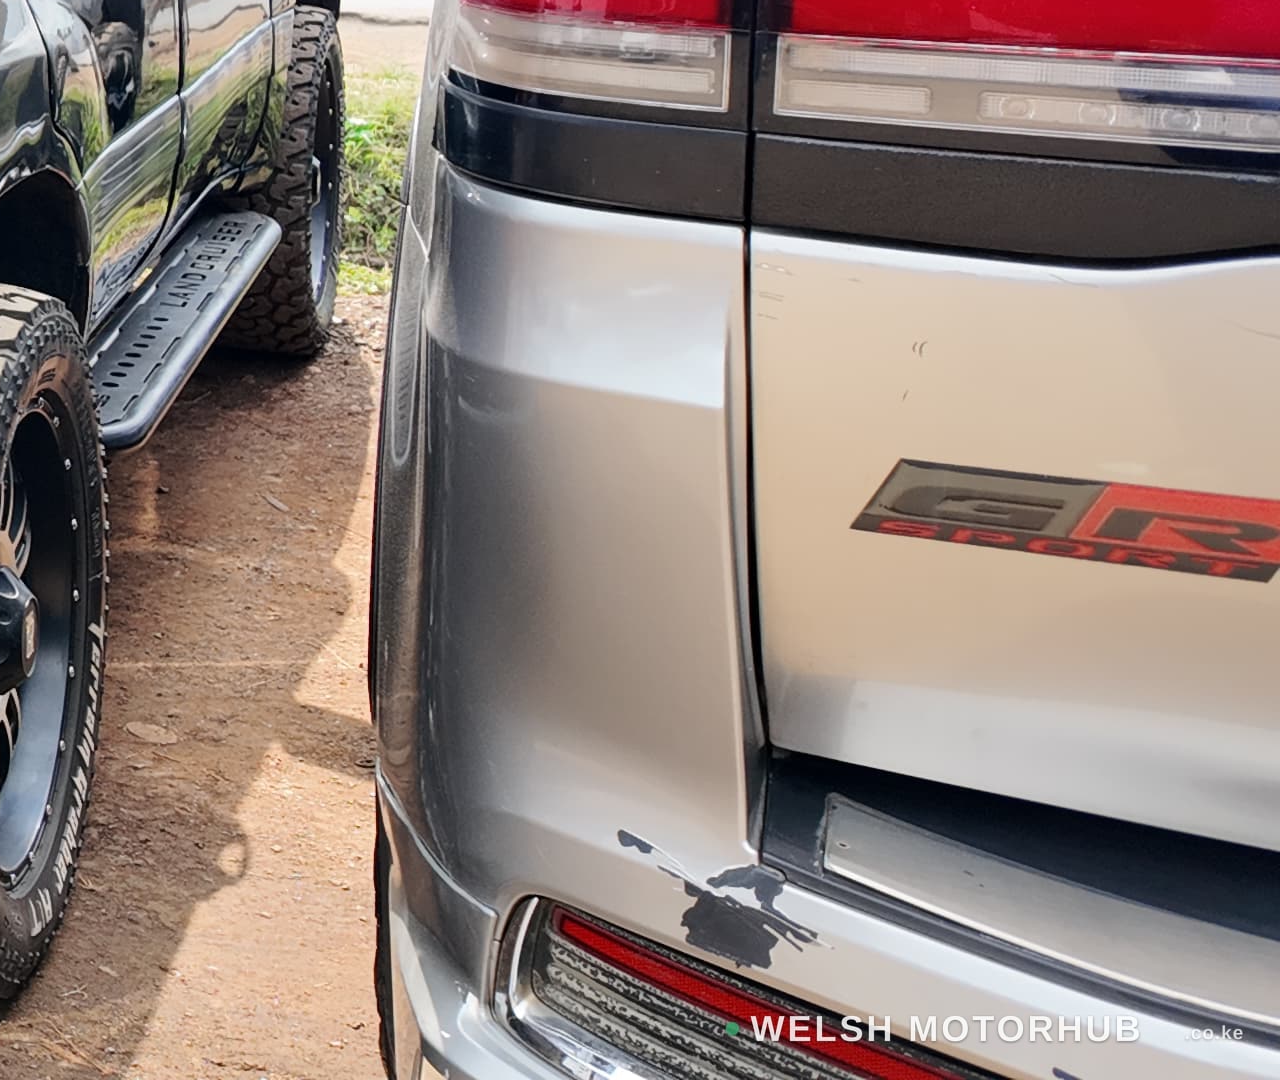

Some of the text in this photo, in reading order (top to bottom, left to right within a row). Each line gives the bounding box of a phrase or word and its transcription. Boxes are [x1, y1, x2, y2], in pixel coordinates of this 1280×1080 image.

[159, 220, 248, 309] LAND CRUISER
[875, 519, 1262, 578] SPORT
[878, 485, 1280, 557] GR
